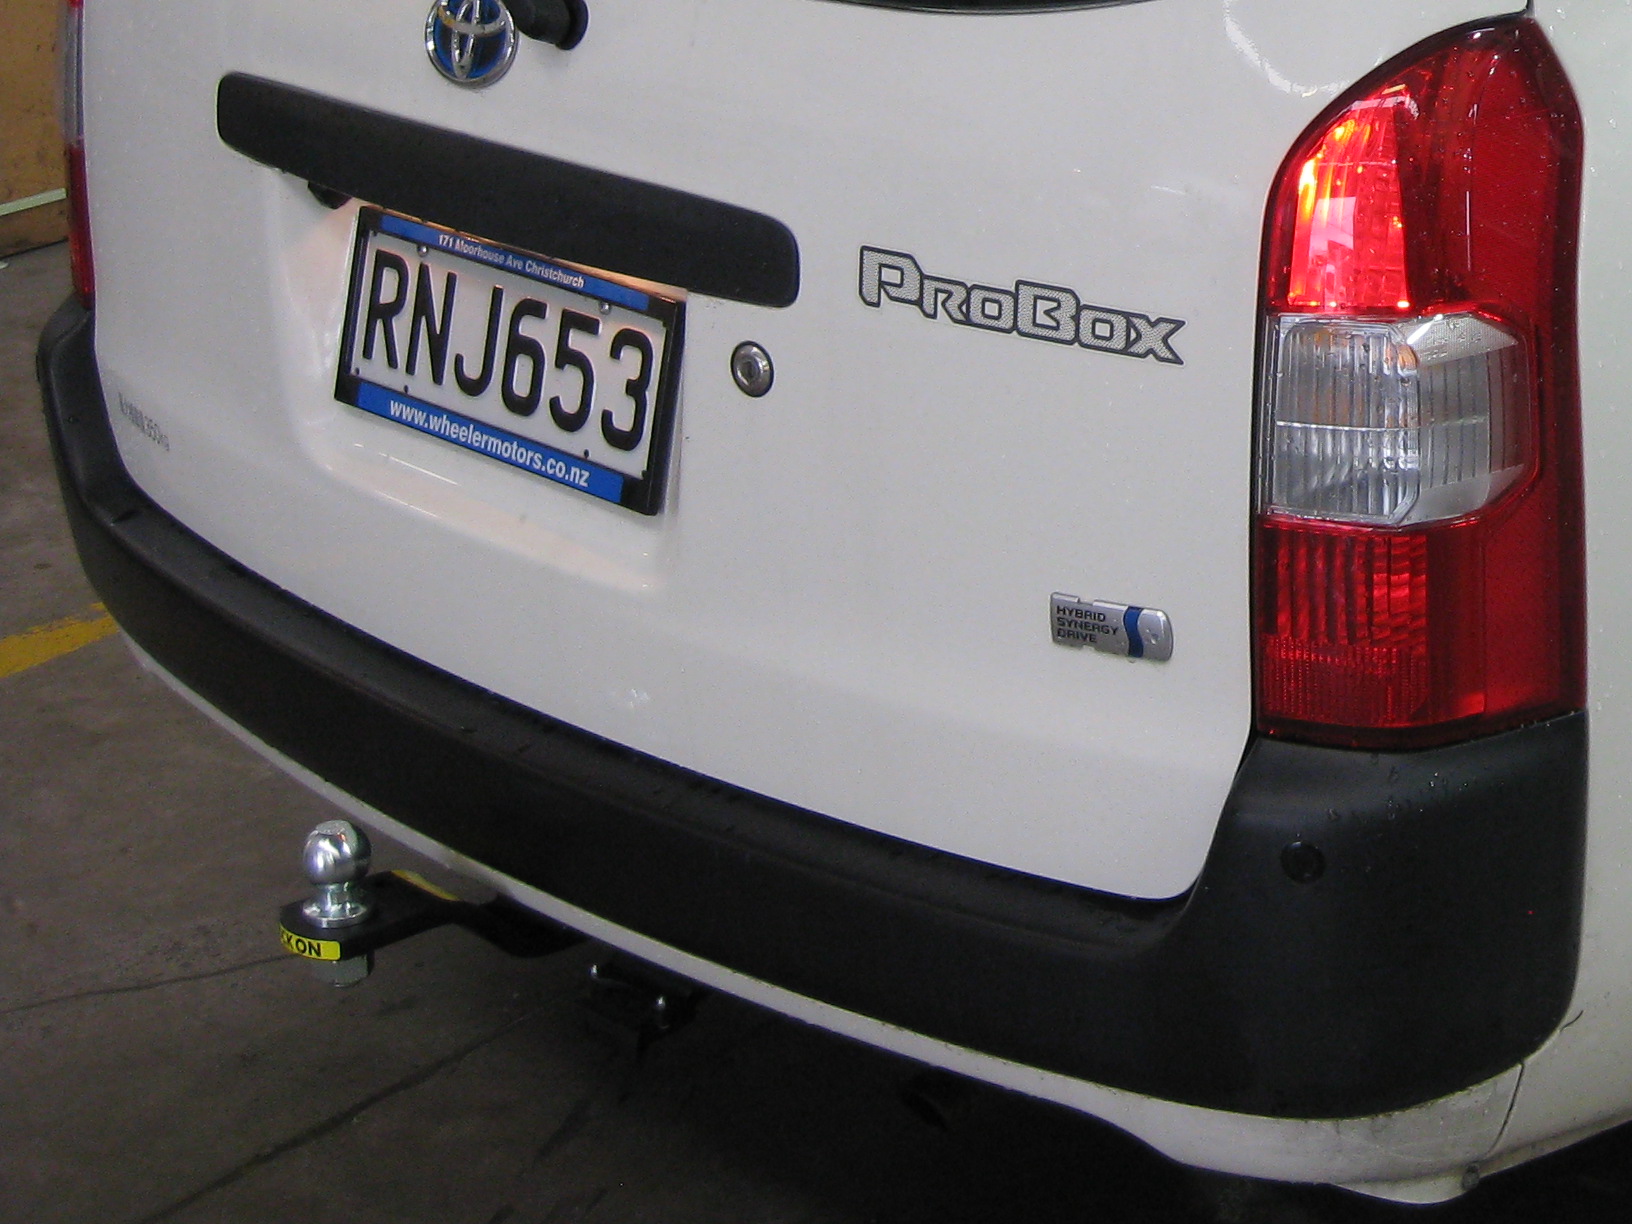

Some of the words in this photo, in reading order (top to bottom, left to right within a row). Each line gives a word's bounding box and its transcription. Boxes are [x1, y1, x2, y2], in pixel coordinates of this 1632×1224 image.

[438, 233, 453, 249] 171
[455, 238, 505, 264] Moorhouse
[505, 254, 523, 271] Ave
[525, 259, 585, 288] Christchurch
[362, 248, 654, 452] RNJ653
[389, 397, 591, 489] www.wheelermotors.co.nz
[1056, 605, 1107, 623] HYBRID
[1056, 617, 1119, 635] SYNERGY
[1057, 627, 1098, 644] DRIVE
